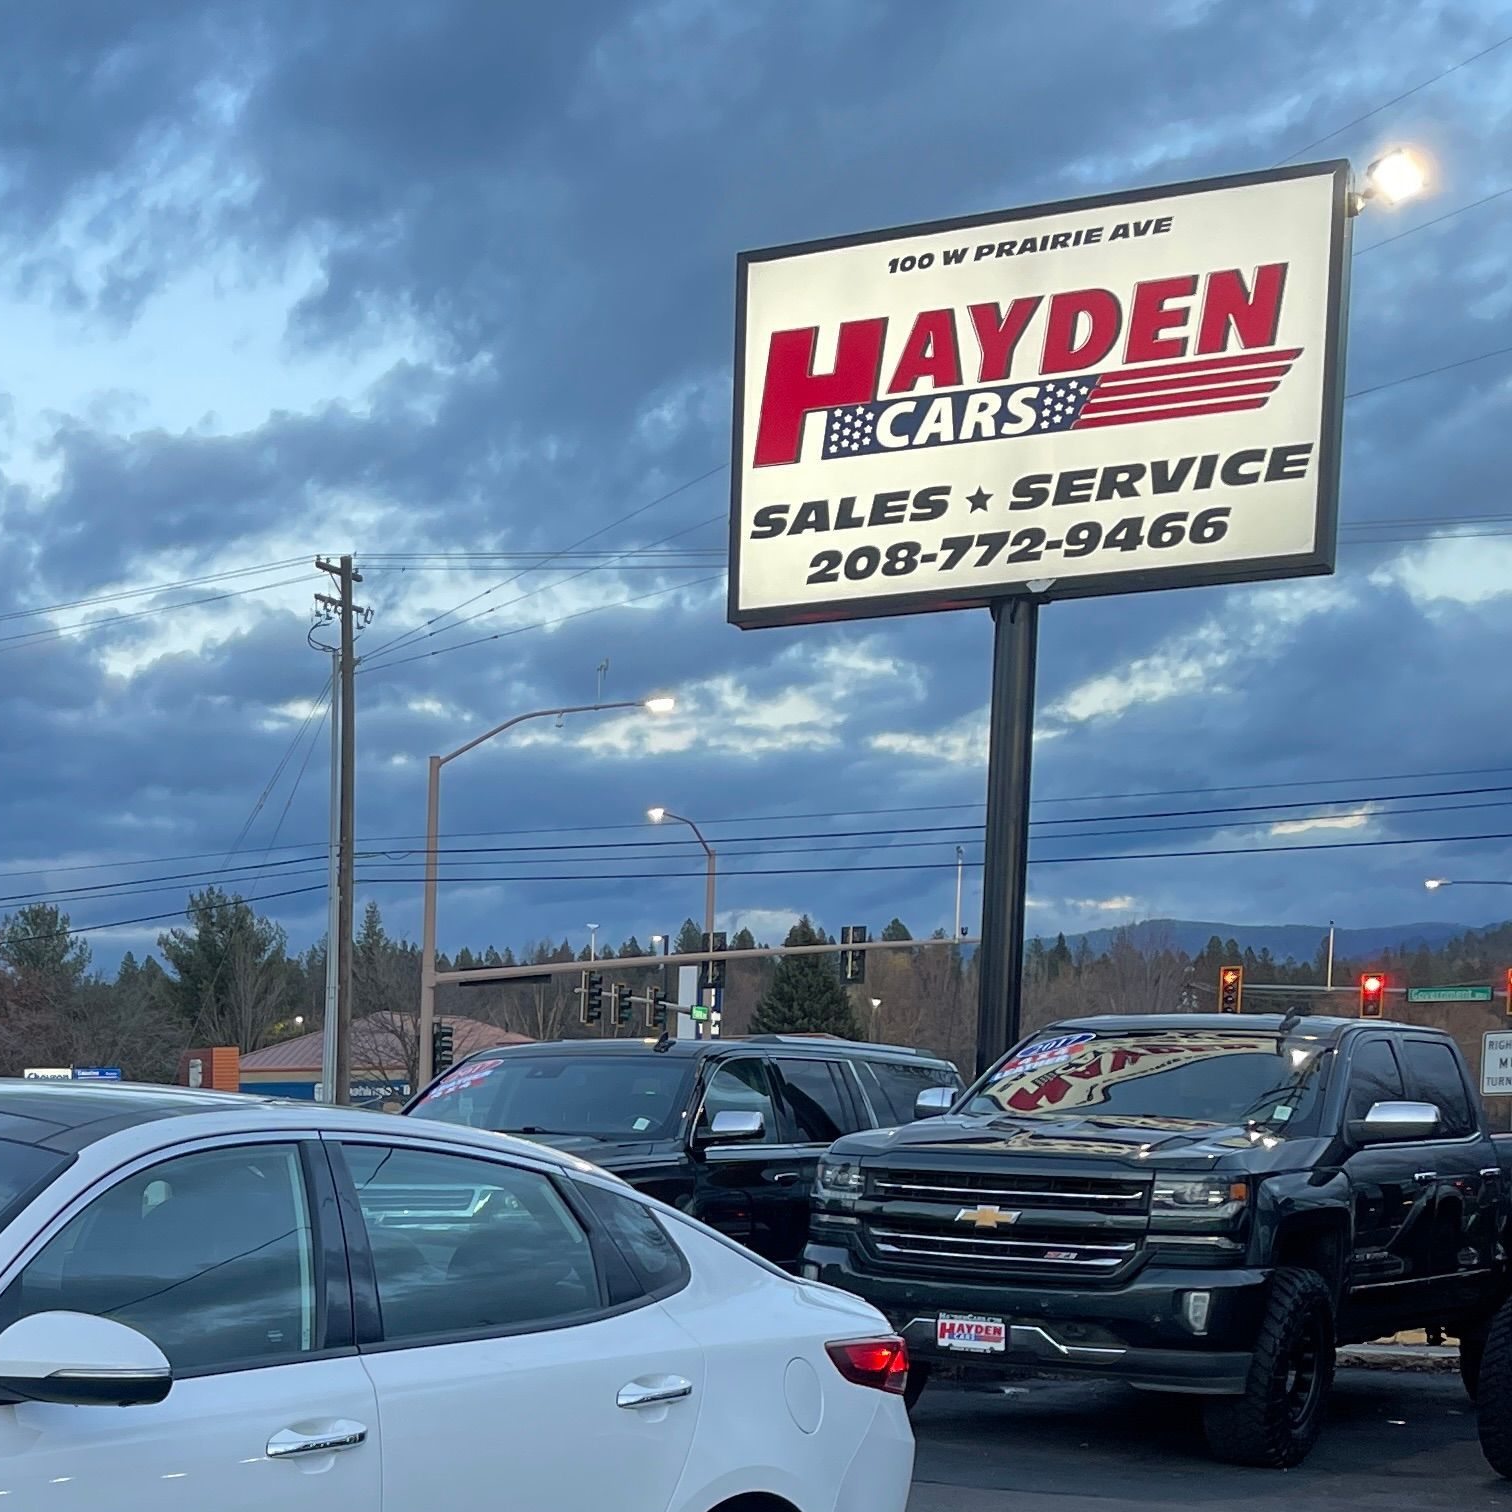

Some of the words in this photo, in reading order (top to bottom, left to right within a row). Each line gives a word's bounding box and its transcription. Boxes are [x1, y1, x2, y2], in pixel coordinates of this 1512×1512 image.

[888, 252, 935, 274] 100
[942, 246, 970, 267] W
[973, 226, 1105, 262] PRAIRIE
[1108, 215, 1175, 242] AVE
[753, 262, 1289, 469] HAYDEN
[875, 384, 1042, 449] CARS
[749, 485, 953, 540] SALES
[1008, 442, 1314, 511] SERVICE
[806, 507, 1233, 586] 208-772-9466
[1499, 1057, 1512, 1069] M
[939, 1322, 1003, 1339] HAYDEN
